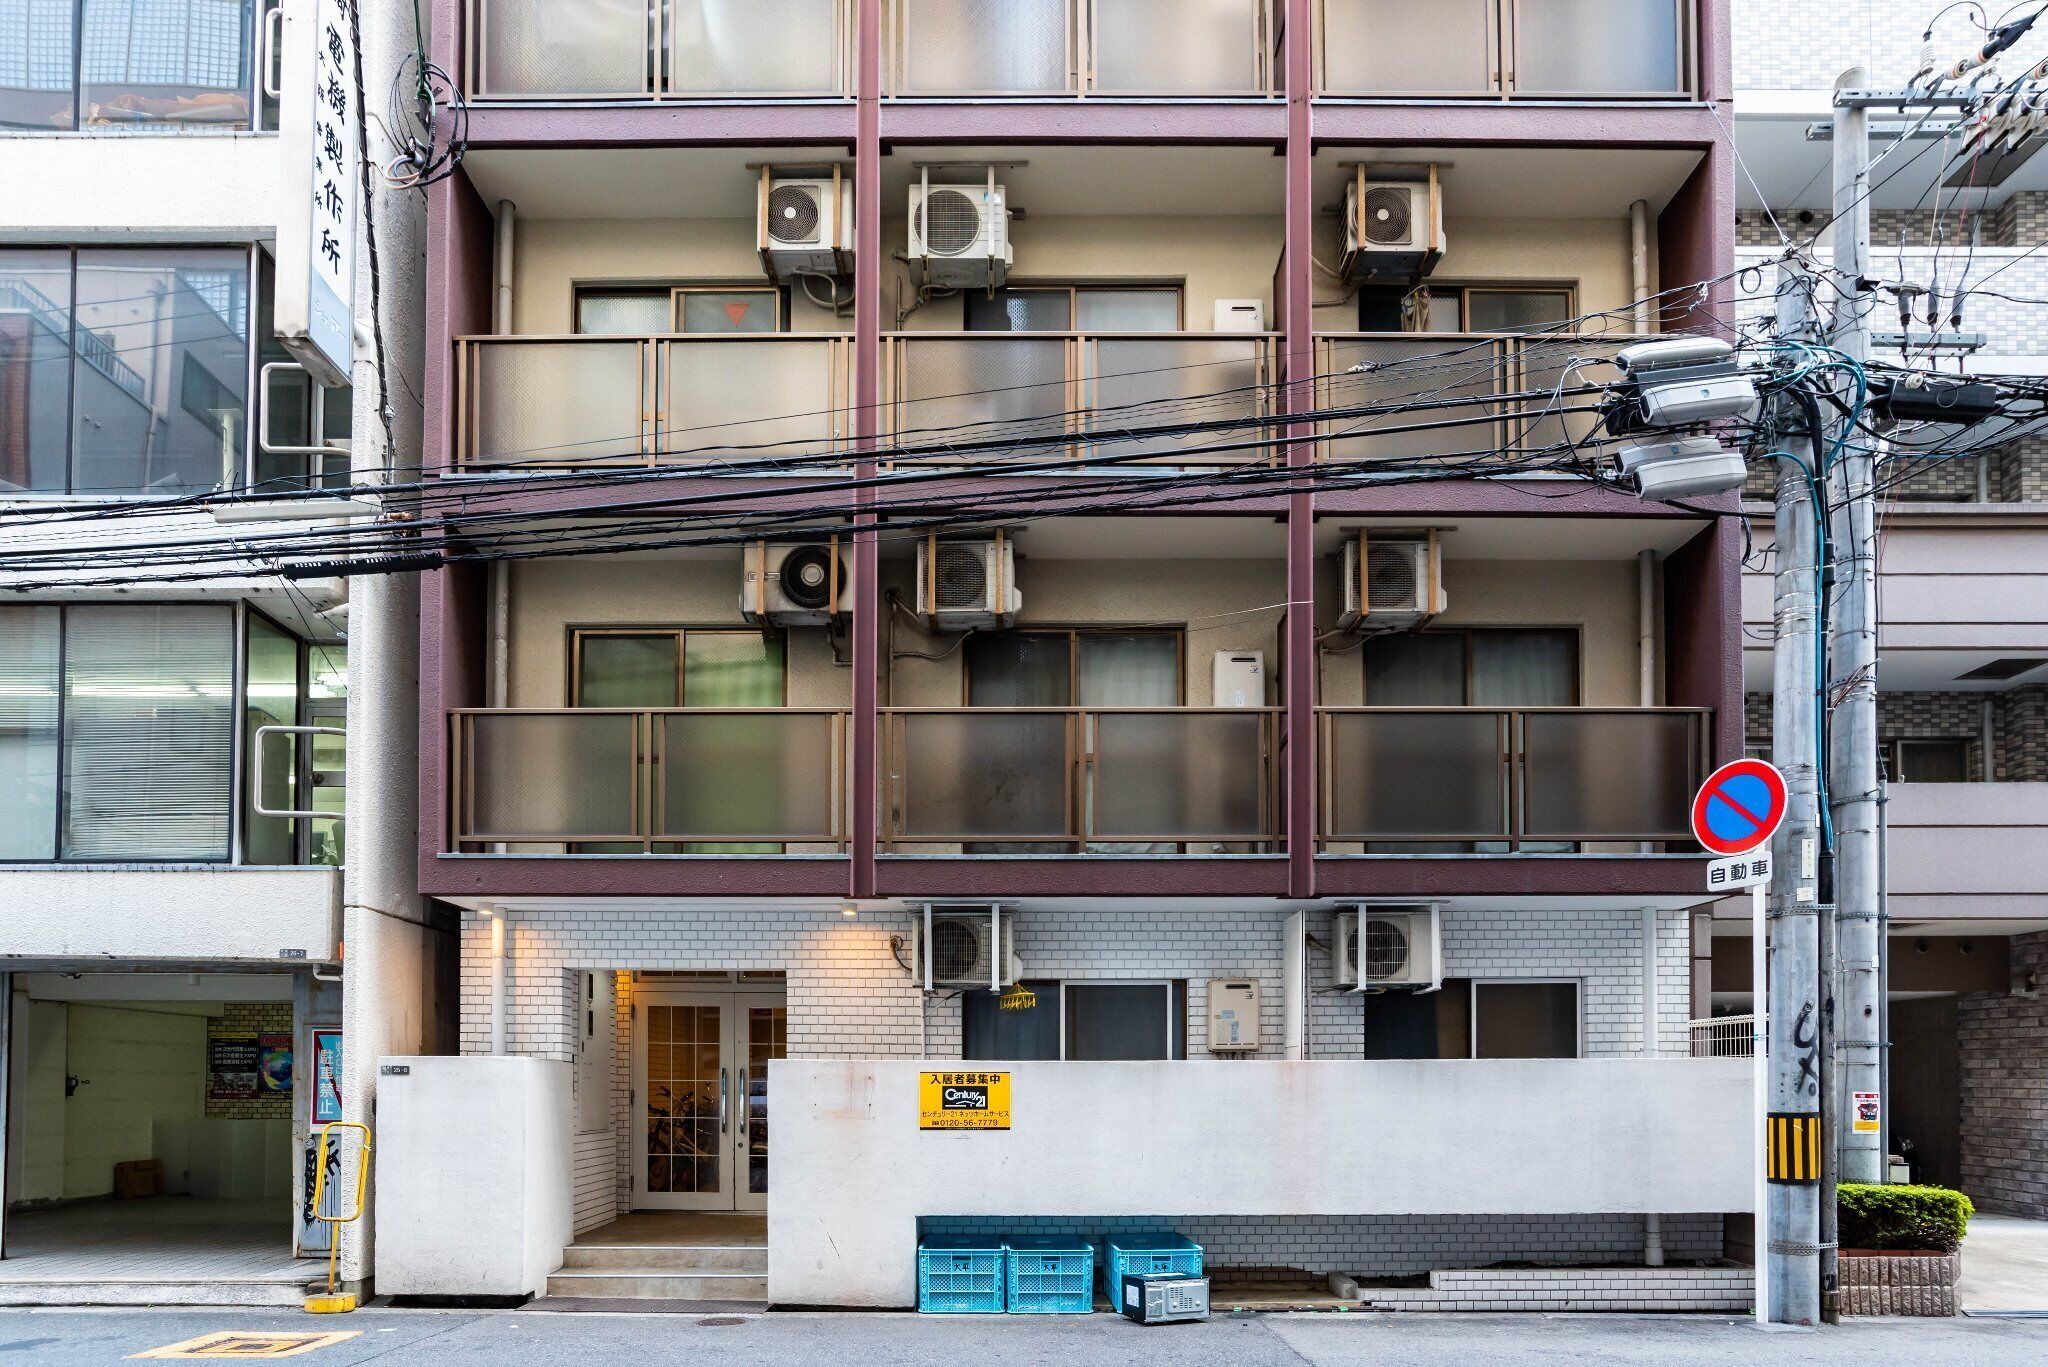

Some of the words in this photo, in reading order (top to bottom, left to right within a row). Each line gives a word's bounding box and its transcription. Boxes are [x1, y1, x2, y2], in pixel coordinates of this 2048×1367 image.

[1711, 860, 1768, 884] 自動車
[319, 1049, 334, 1114] 駐車禁止
[931, 1074, 1000, 1084] 入居者募集中
